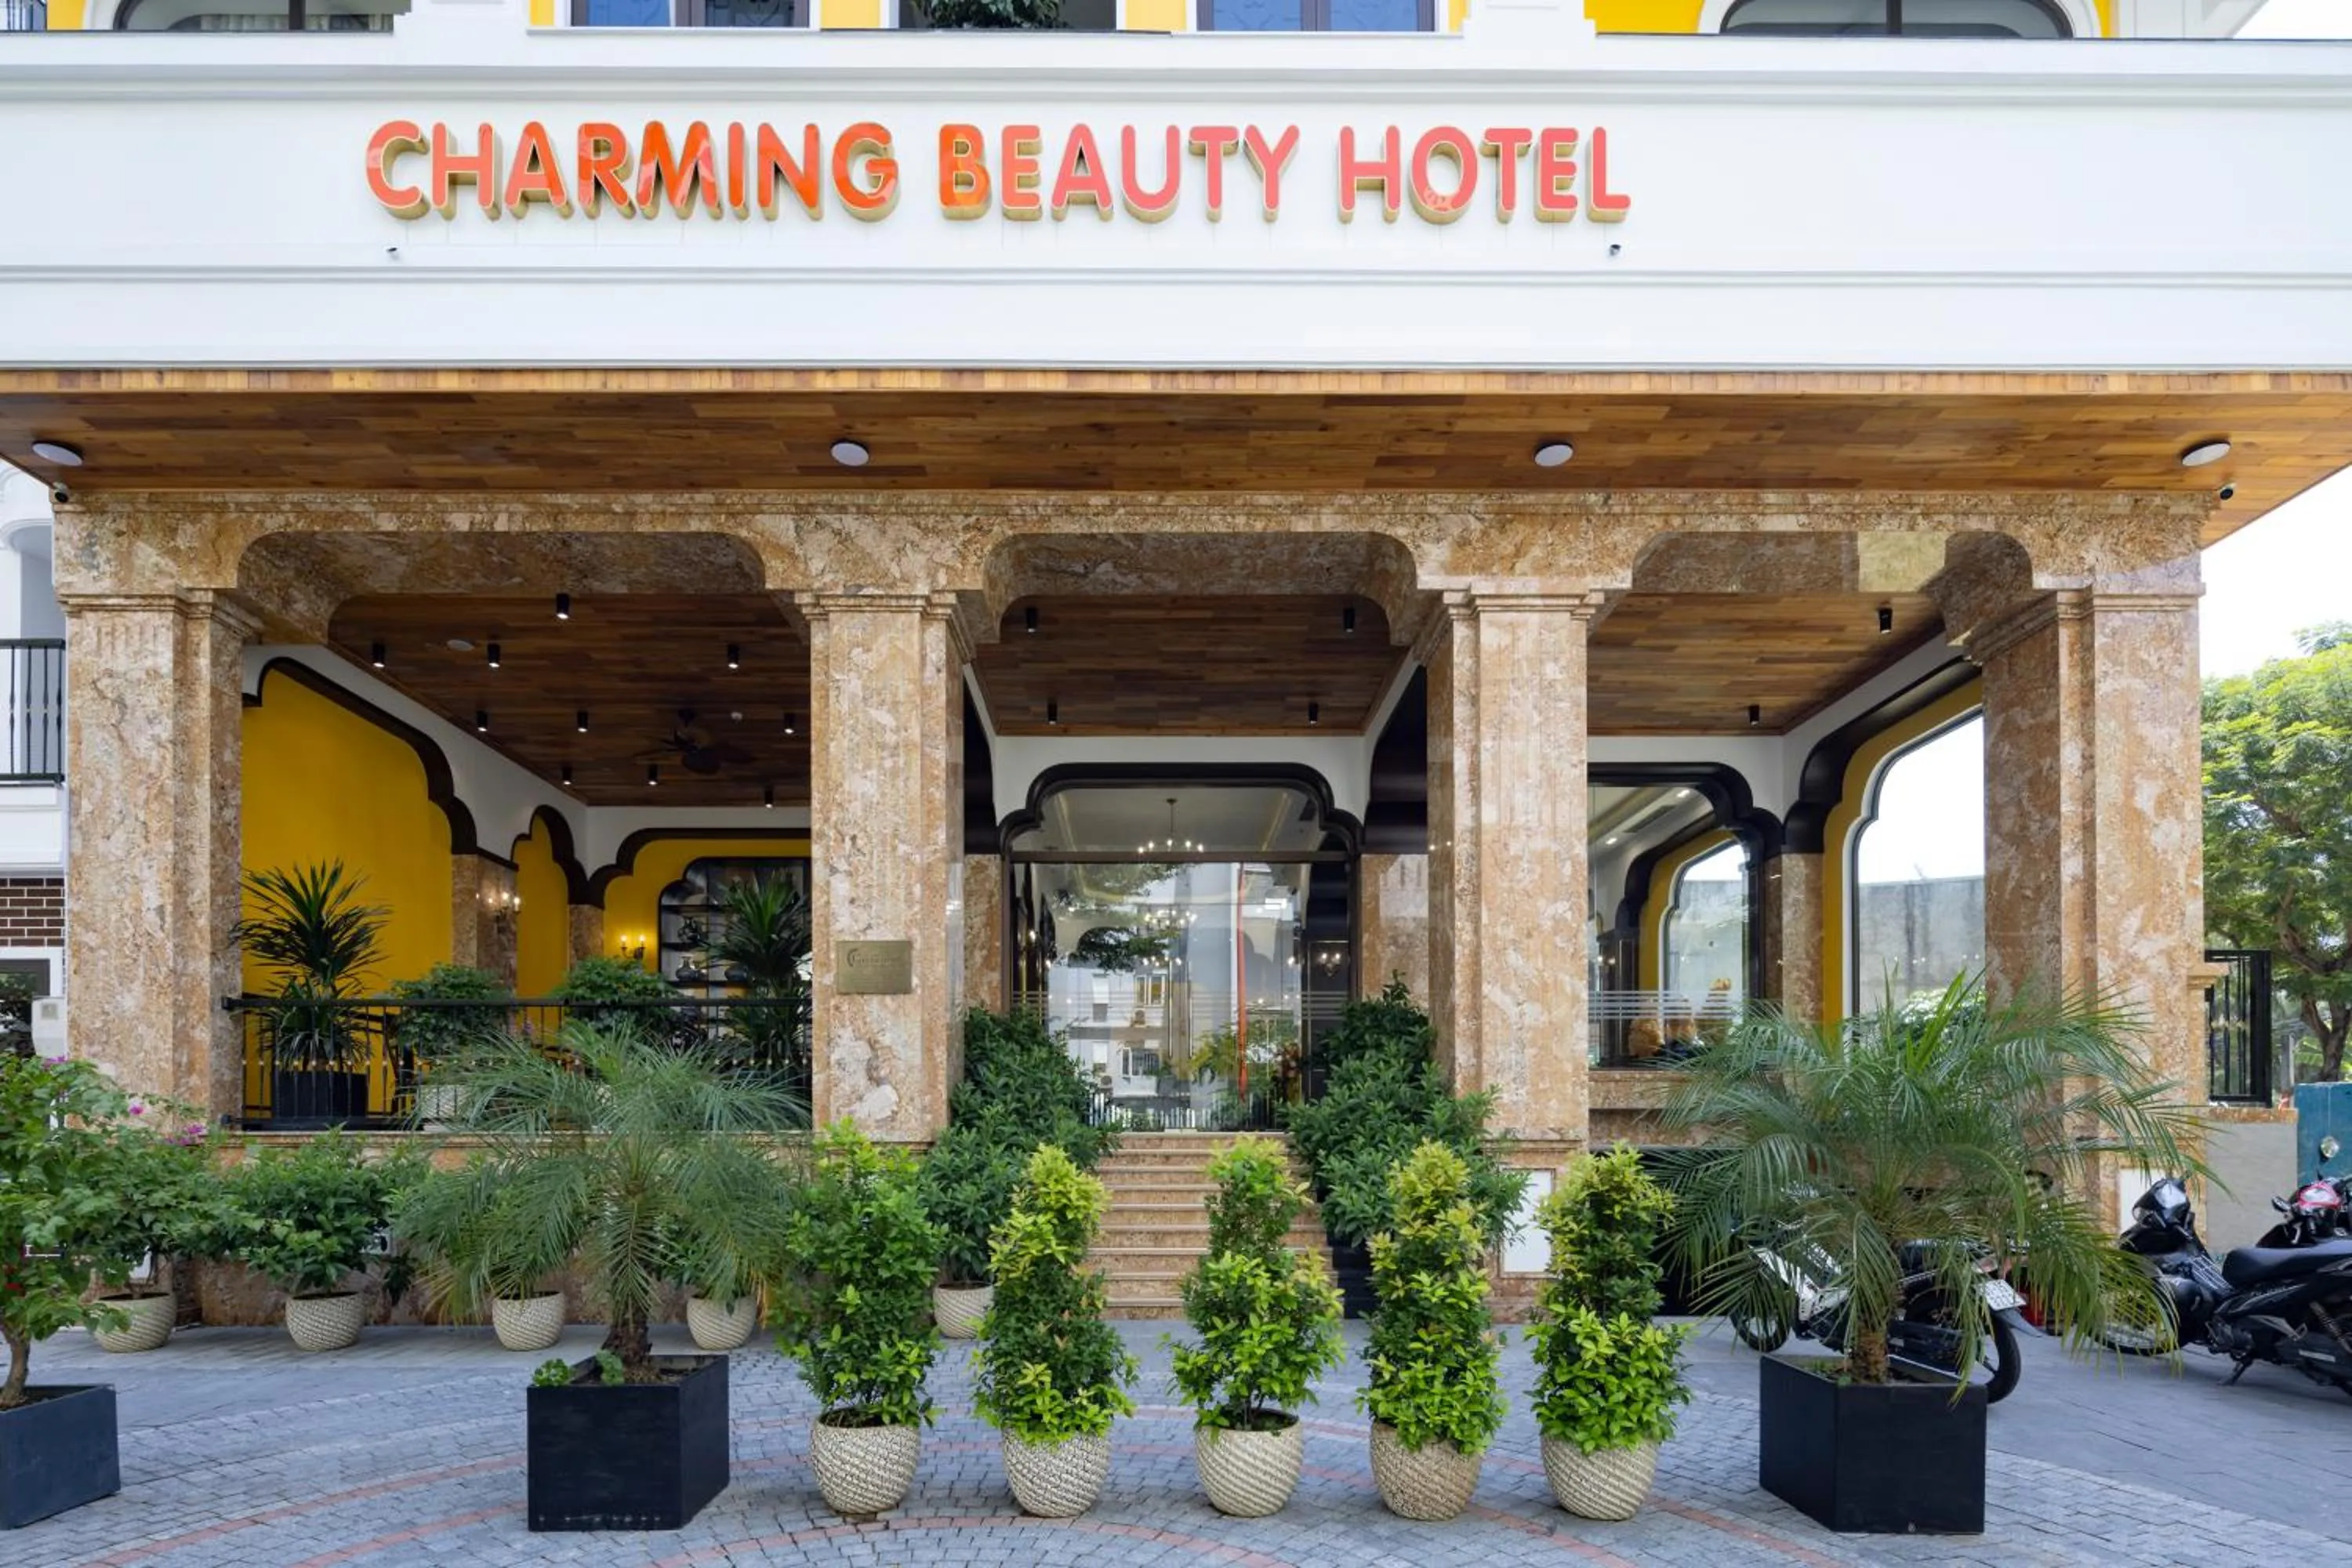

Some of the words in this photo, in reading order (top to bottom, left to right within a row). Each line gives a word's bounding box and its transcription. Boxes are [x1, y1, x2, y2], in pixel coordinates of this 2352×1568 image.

[365, 120, 900, 221] CHARMING
[938, 123, 1301, 222] BEAUTY
[1339, 125, 1632, 224] HOTEL
